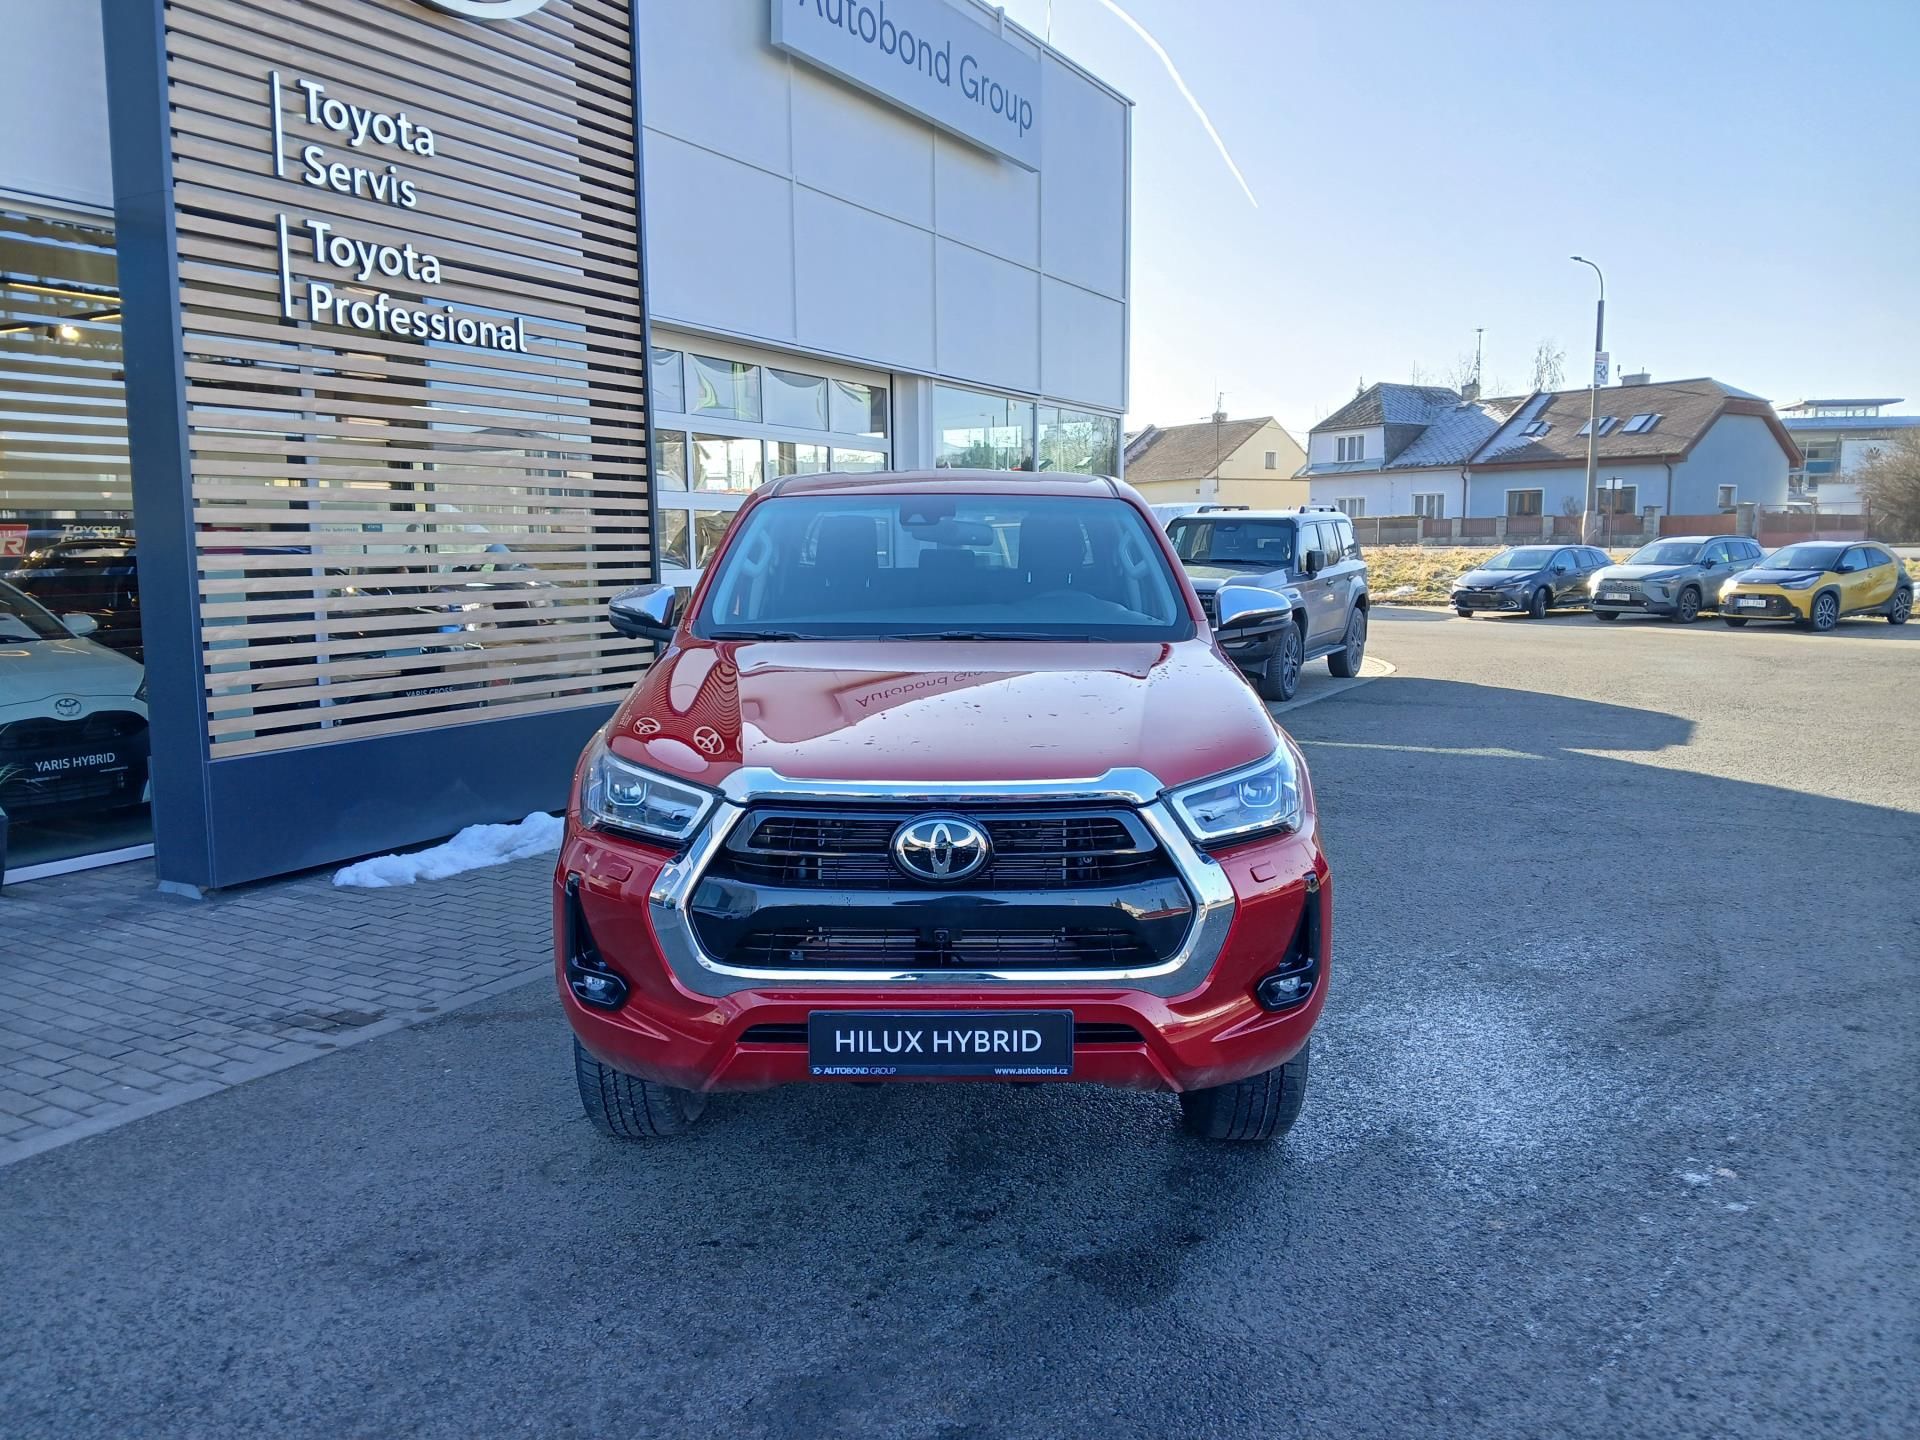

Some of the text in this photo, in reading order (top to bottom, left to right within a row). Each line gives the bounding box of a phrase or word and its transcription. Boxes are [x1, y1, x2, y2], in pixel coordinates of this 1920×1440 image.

[959, 54, 1033, 138] Group
[298, 78, 437, 158] Toyota
[302, 145, 418, 208] Servis
[305, 219, 442, 285] Toyota
[308, 282, 529, 353] Professional
[61, 524, 121, 534] TOYOTA
[35, 752, 116, 772] YARIS HYBRID
[835, 1029, 1043, 1053] HILUX HYBRID
[823, 1066, 897, 1075] AUTOBOND GROUP
[994, 1066, 1069, 1075] www.autobond.cz
